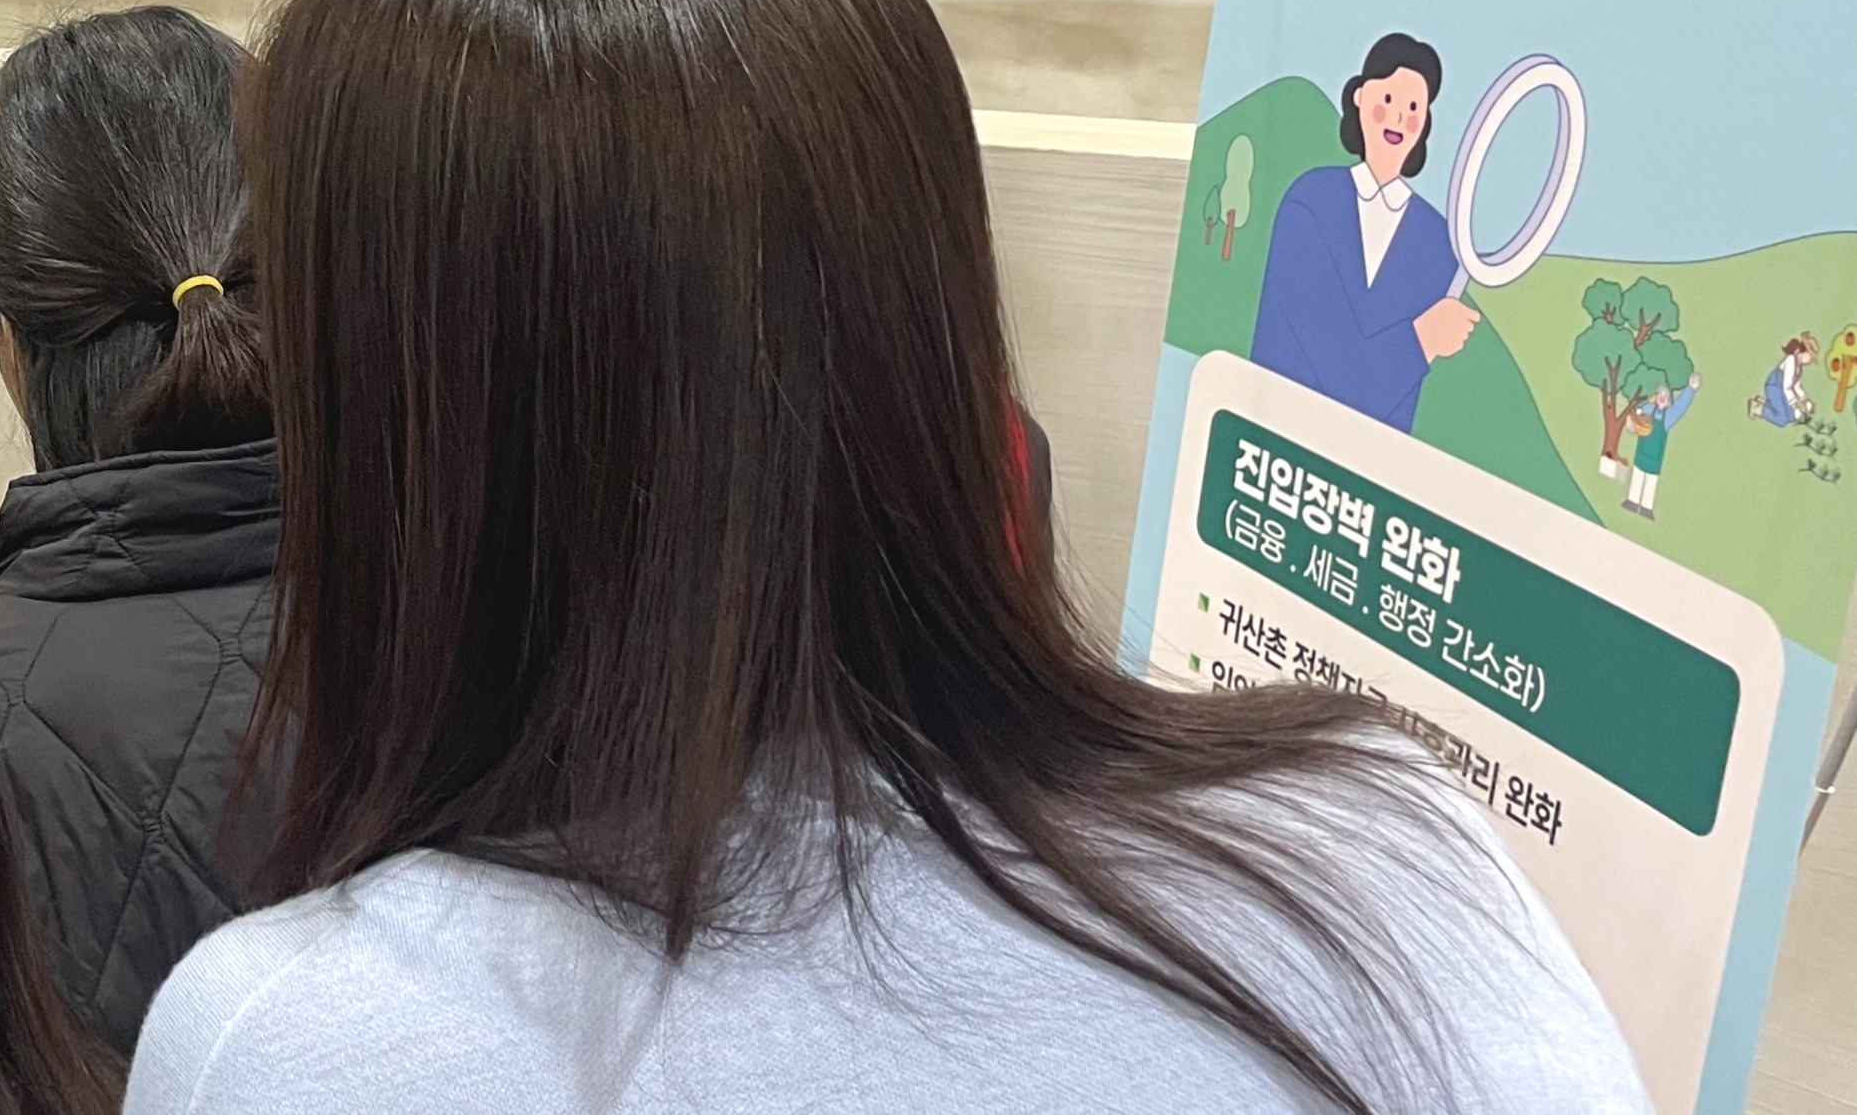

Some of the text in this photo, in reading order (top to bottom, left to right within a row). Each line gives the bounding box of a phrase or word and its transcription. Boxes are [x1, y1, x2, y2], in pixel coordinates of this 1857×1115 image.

[1224, 499, 1287, 564] (금융
[1303, 544, 1359, 606] 세금
[1378, 583, 1437, 648] 행정
[1441, 618, 1546, 713] 간소화)
[1233, 438, 1461, 604] 진입장벽 완화
[1218, 598, 1288, 671] 귀산촌
[1504, 775, 1563, 846] 완화
